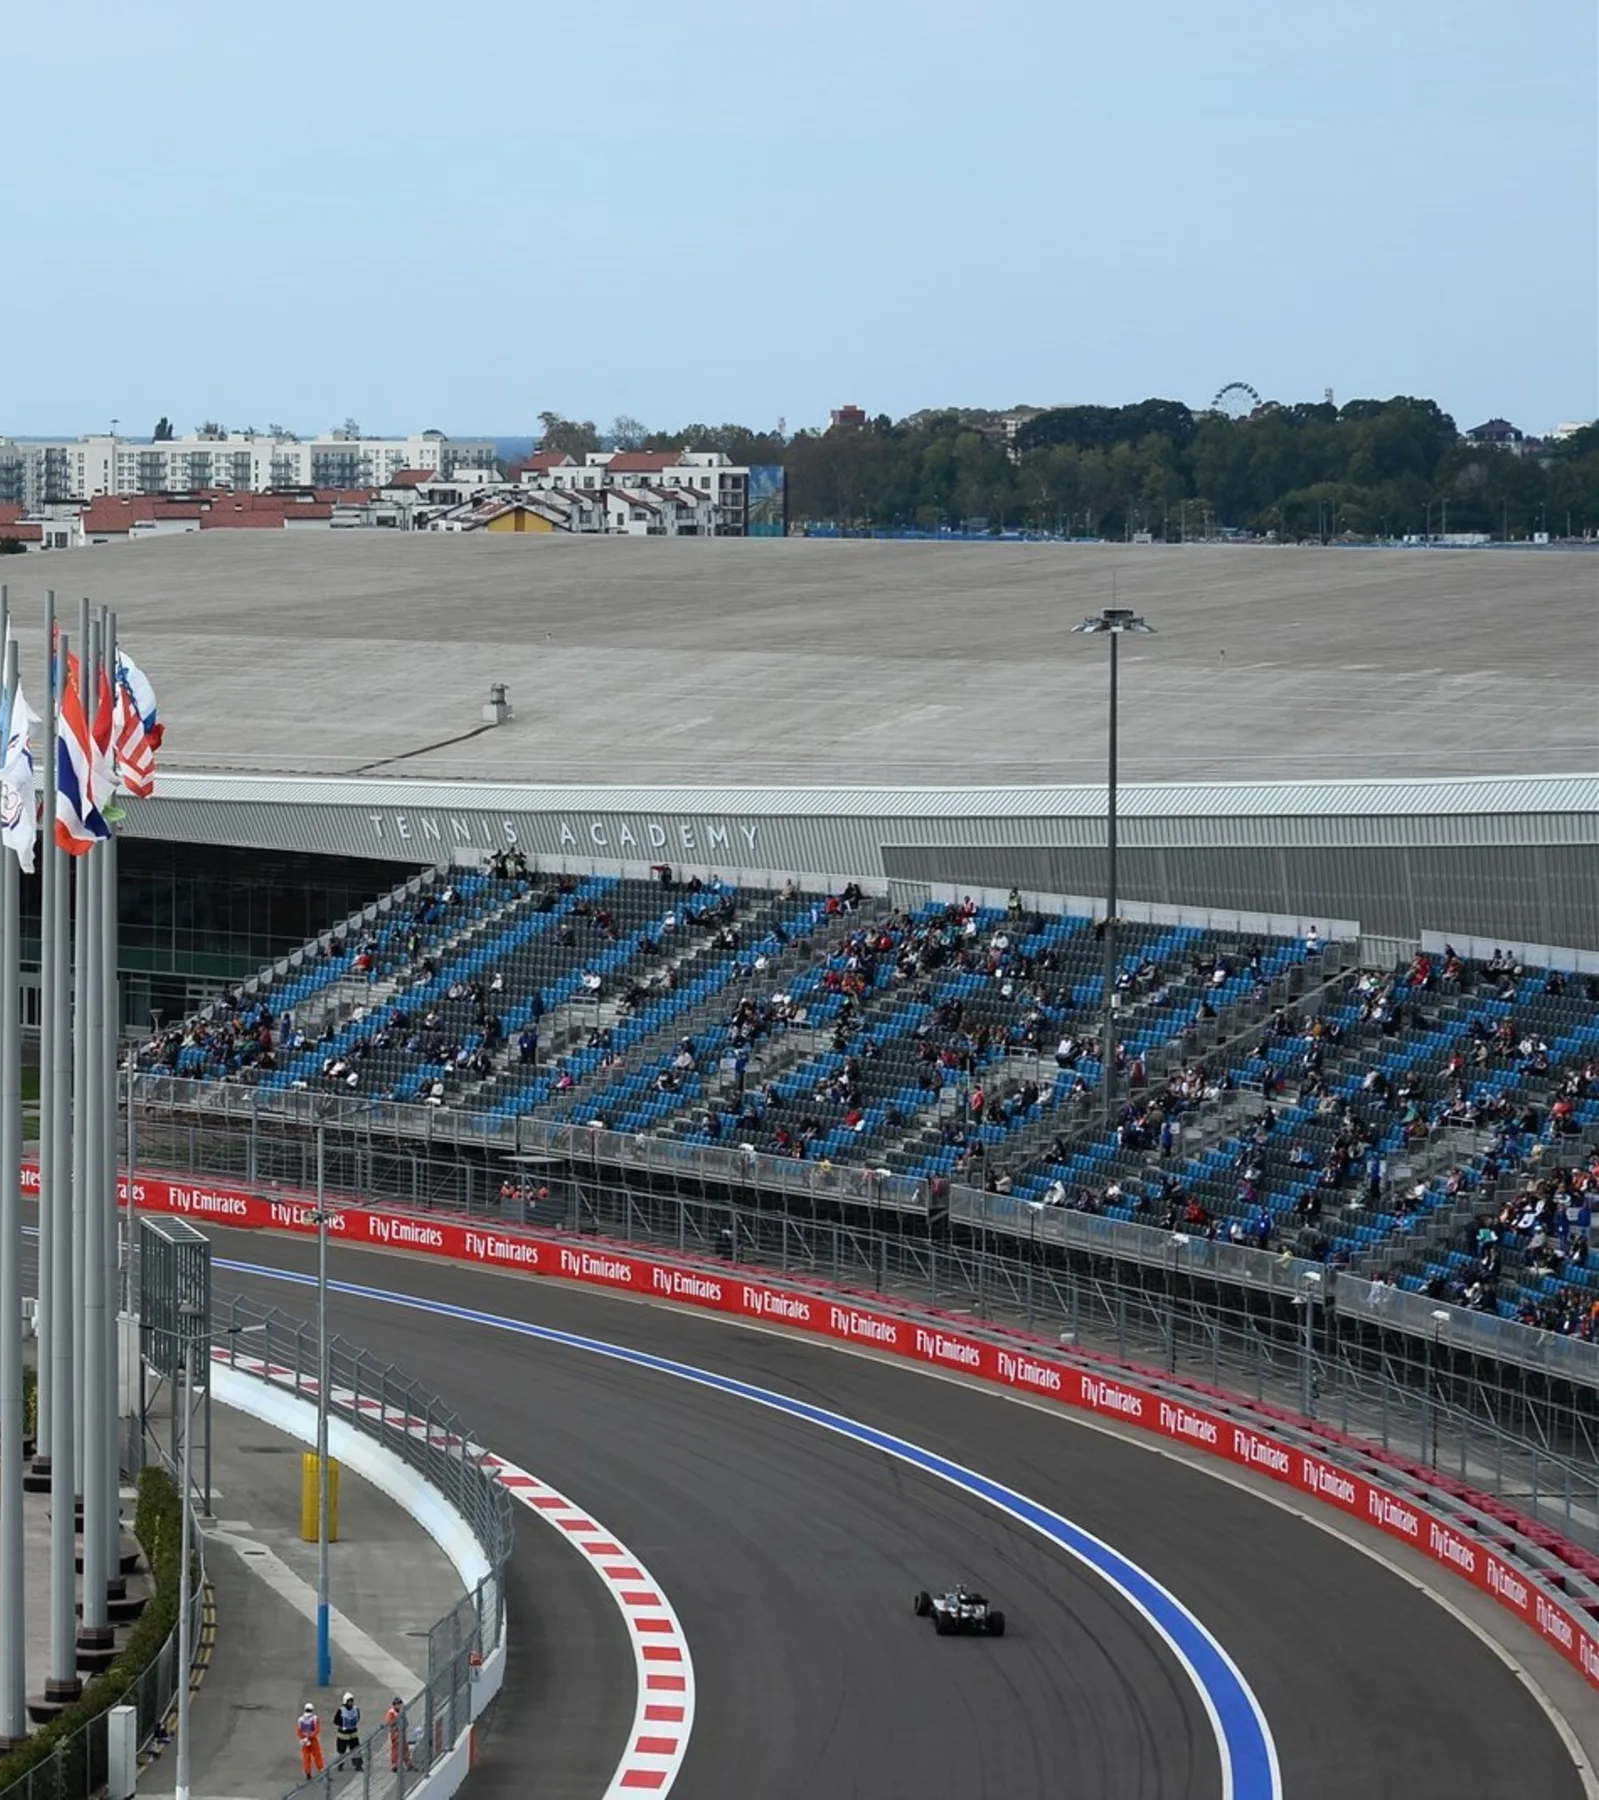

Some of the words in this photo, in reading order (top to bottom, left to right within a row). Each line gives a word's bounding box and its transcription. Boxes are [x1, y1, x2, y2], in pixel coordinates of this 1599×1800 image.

[370, 815, 518, 843] TENNIS
[560, 822, 758, 849] ACADEMY
[169, 1187, 190, 1211] Fly
[192, 1190, 247, 1215] Emirates
[271, 1202, 291, 1226] Fly
[369, 1216, 390, 1241] Fly
[391, 1220, 443, 1246] Emirates
[465, 1233, 486, 1258] Fly
[487, 1237, 538, 1264] Emirates
[561, 1250, 580, 1276] Fly
[582, 1254, 632, 1282] Emirates
[653, 1268, 672, 1293] Fly
[673, 1272, 722, 1301] Emirates
[743, 1287, 762, 1314] Fly
[763, 1290, 810, 1321] Emirates
[830, 1308, 849, 1336] Fly
[850, 1311, 897, 1343] Emirates
[916, 1330, 934, 1358] Fly
[935, 1334, 980, 1367] Emirates
[998, 1352, 1015, 1382] Fly
[1017, 1356, 1061, 1390] Emirates
[1081, 1377, 1098, 1407] Fly
[1099, 1382, 1142, 1417] Emirates
[1160, 1403, 1176, 1433] Fly
[1177, 1408, 1217, 1444] Emirates
[1234, 1429, 1250, 1461] Fly
[1251, 1436, 1289, 1473] Emirates
[1303, 1458, 1318, 1492] Fly
[1319, 1465, 1355, 1504] Emirates
[1369, 1489, 1383, 1524] Fly
[1384, 1497, 1418, 1537] Emirates
[1430, 1523, 1443, 1558] Fly
[1443, 1530, 1475, 1572] Emirates
[1487, 1558, 1500, 1593] Fly
[1499, 1566, 1528, 1609] Emirates
[1536, 1596, 1547, 1634] Fly
[1547, 1604, 1572, 1649] Emirates
[1579, 1634, 1590, 1674] Fly
